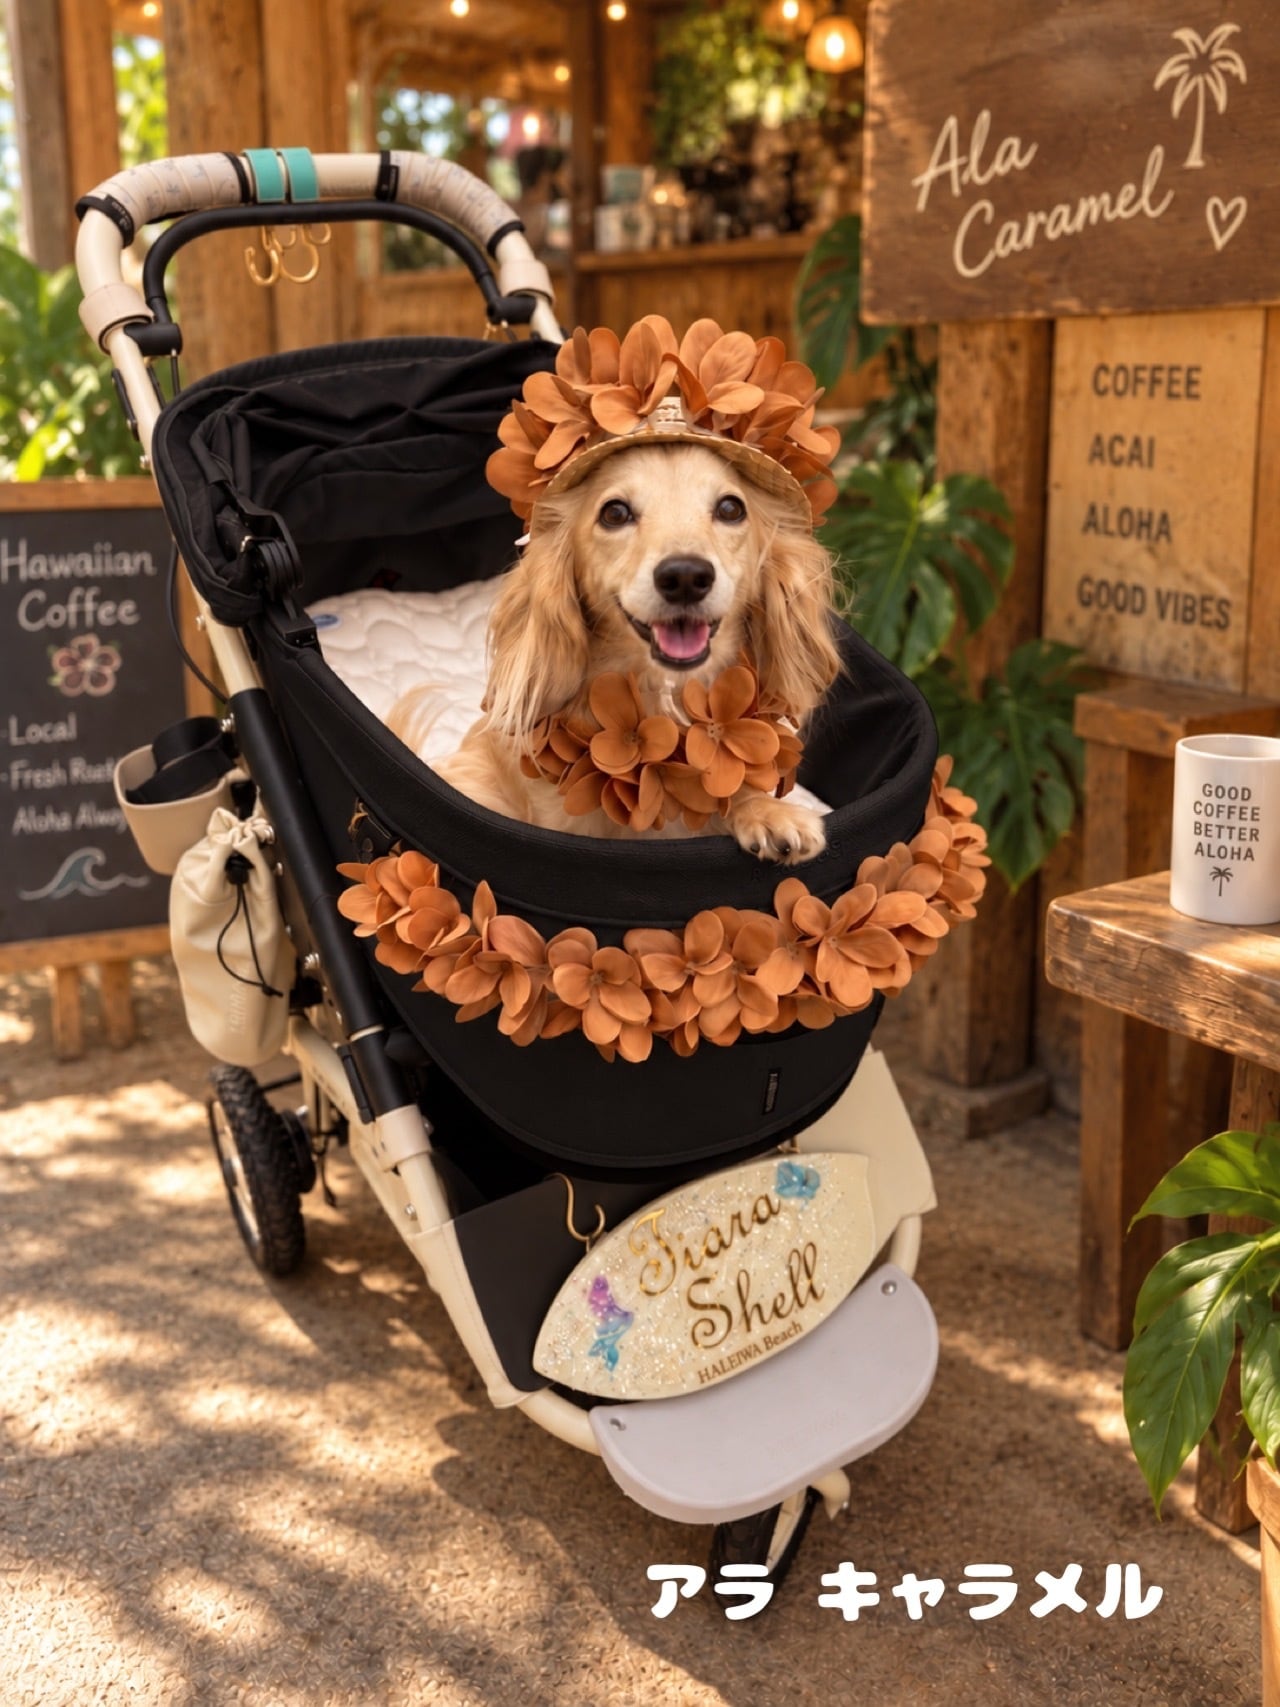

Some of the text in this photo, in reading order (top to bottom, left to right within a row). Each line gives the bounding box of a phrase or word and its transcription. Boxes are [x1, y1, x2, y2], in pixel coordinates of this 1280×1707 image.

[911, 109, 1038, 213] Ala
[953, 144, 1175, 278] Caramel
[1092, 364, 1202, 401] COFFEE
[1087, 433, 1156, 469] ACAI
[1081, 503, 1173, 544] ALOHA
[0, 537, 157, 583] Hawaiian
[17, 585, 141, 632] Coffee
[1077, 573, 1233, 632] GOOD VIBES
[8, 711, 78, 746] Local
[10, 757, 68, 791] Fresh
[1202, 783, 1252, 801] GOOD
[12, 800, 128, 837] Aloha Alway
[1193, 800, 1261, 822] COFFEE
[1193, 821, 1260, 842] BETTER
[1194, 841, 1255, 862] ALOHA
[628, 1193, 781, 1297] Tiara
[686, 1242, 825, 1349] Shell
[697, 1319, 804, 1385] HALEIWA Beach
